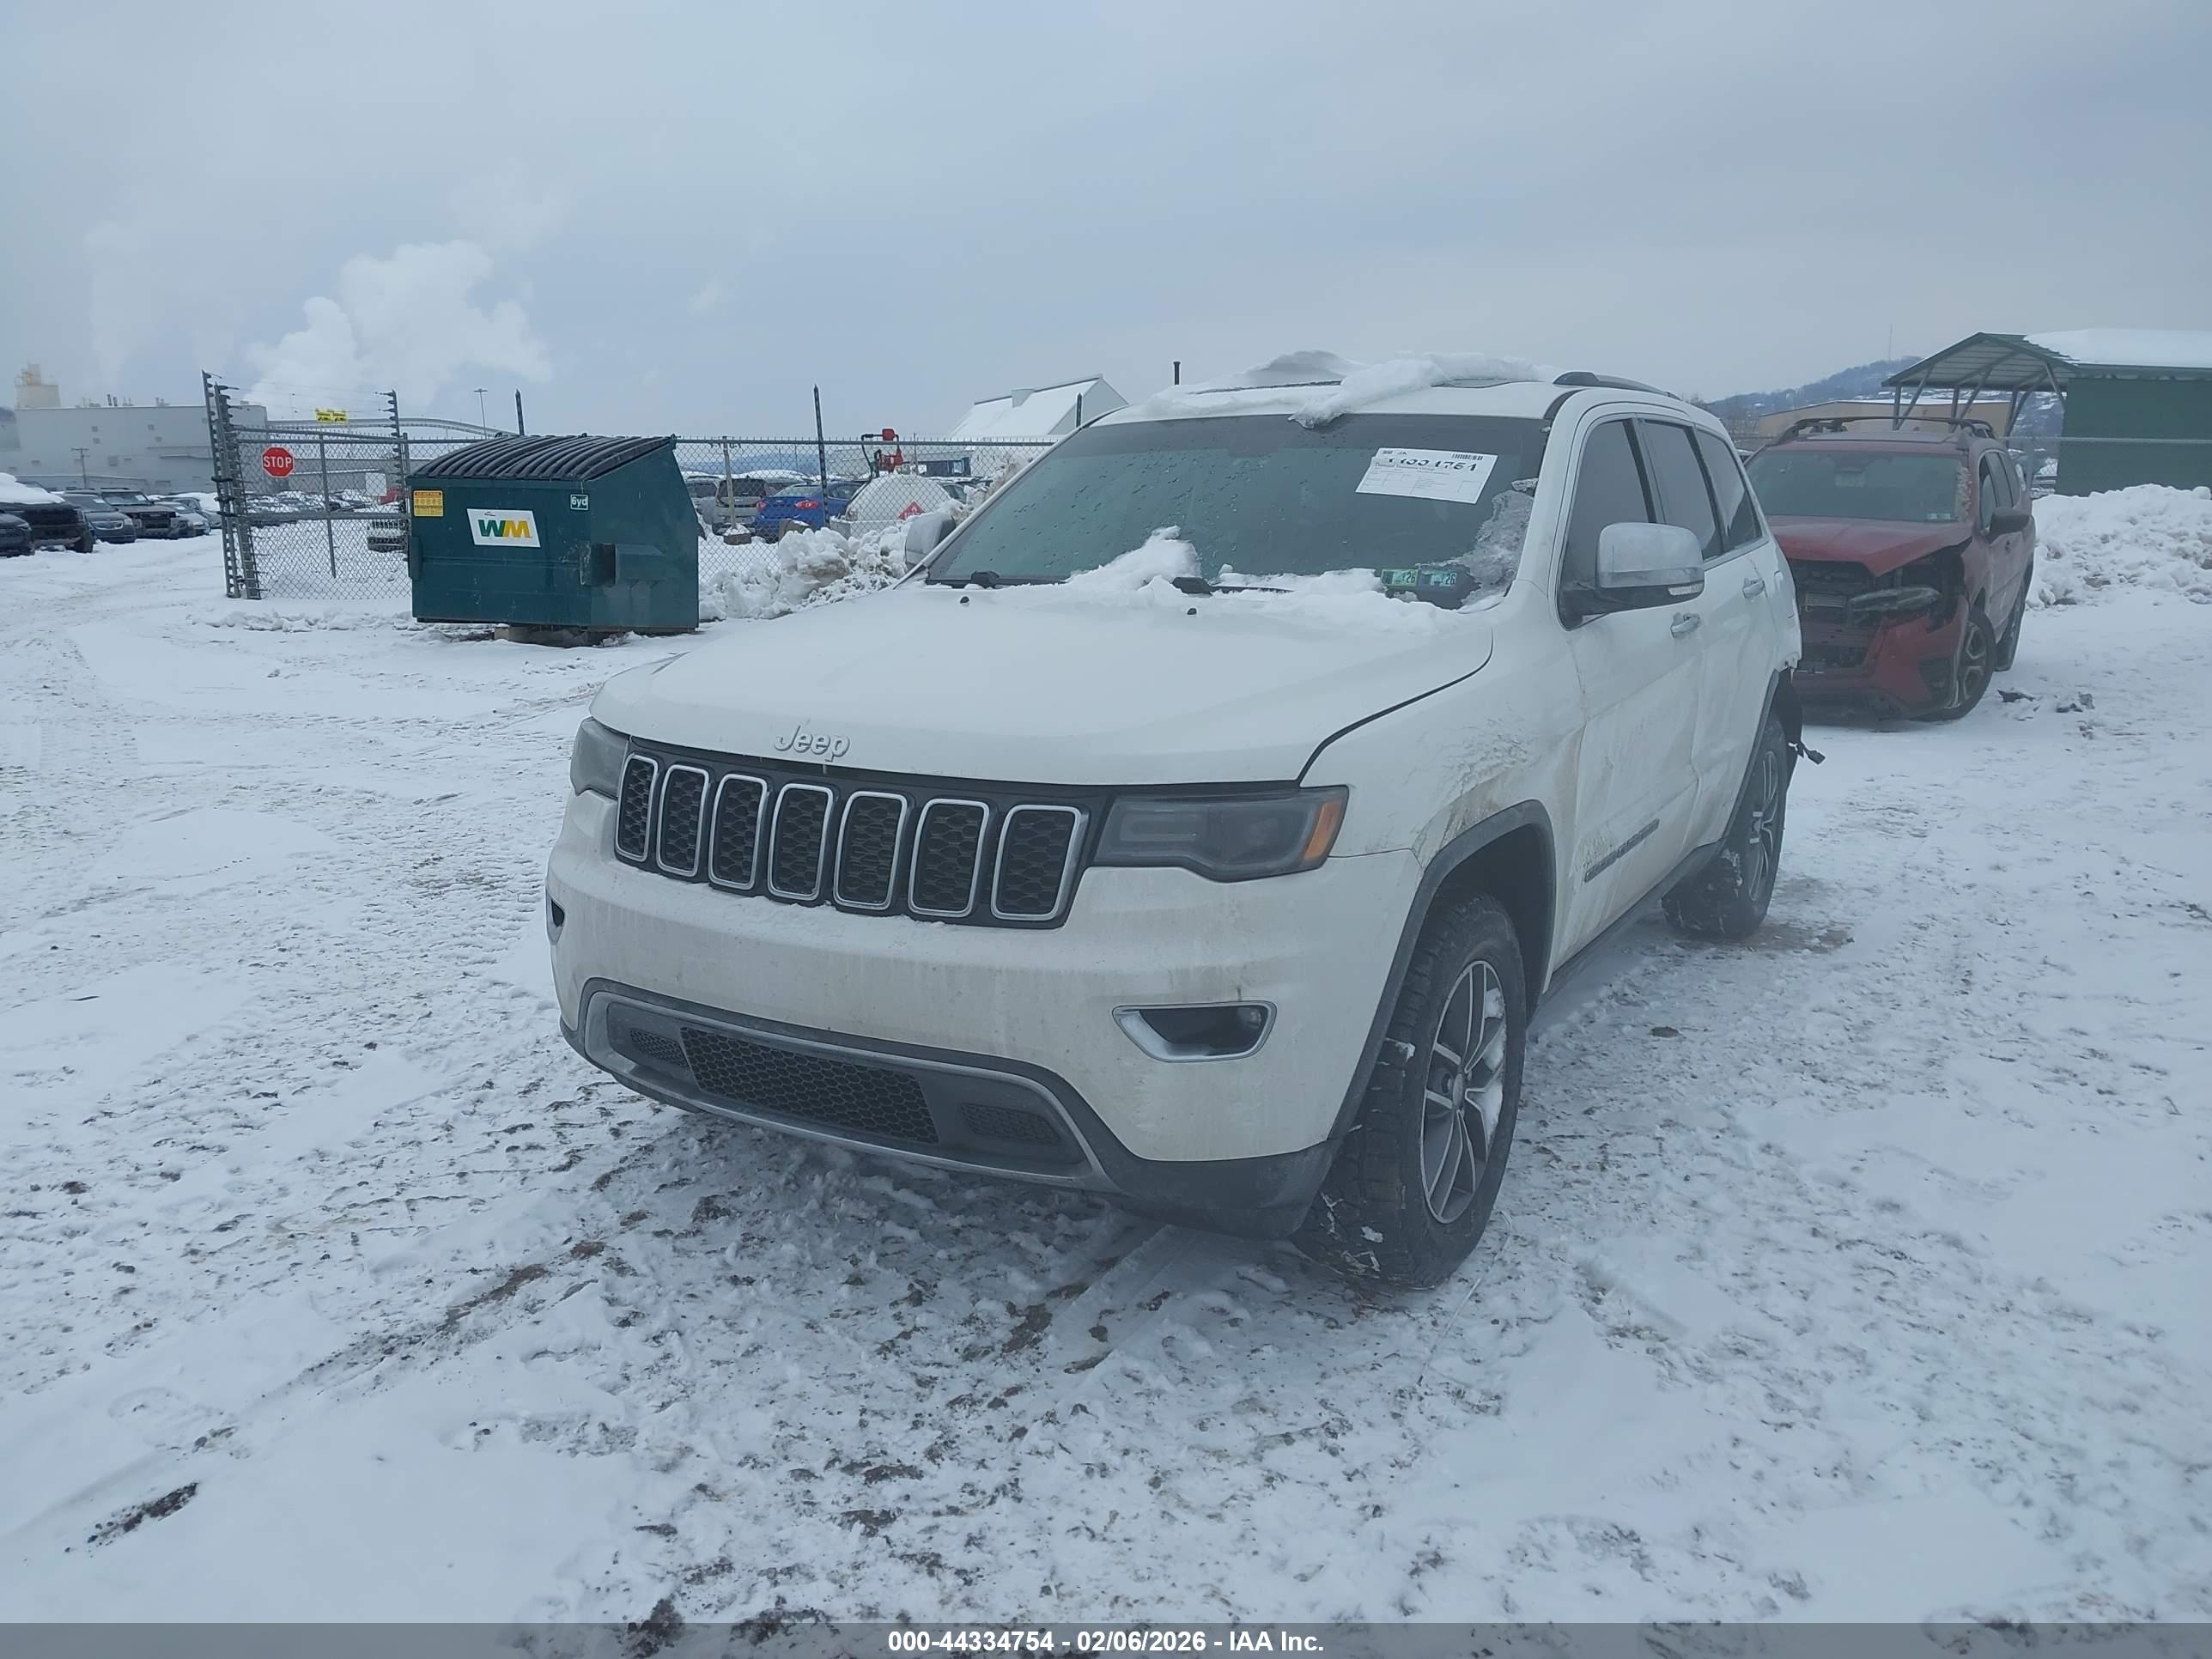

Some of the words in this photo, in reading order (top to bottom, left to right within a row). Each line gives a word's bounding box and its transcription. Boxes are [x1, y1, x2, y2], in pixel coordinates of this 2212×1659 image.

[263, 455, 292, 468] STOP
[571, 496, 587, 507] 6yd
[477, 520, 530, 538] WM
[774, 725, 850, 763] Jeep
